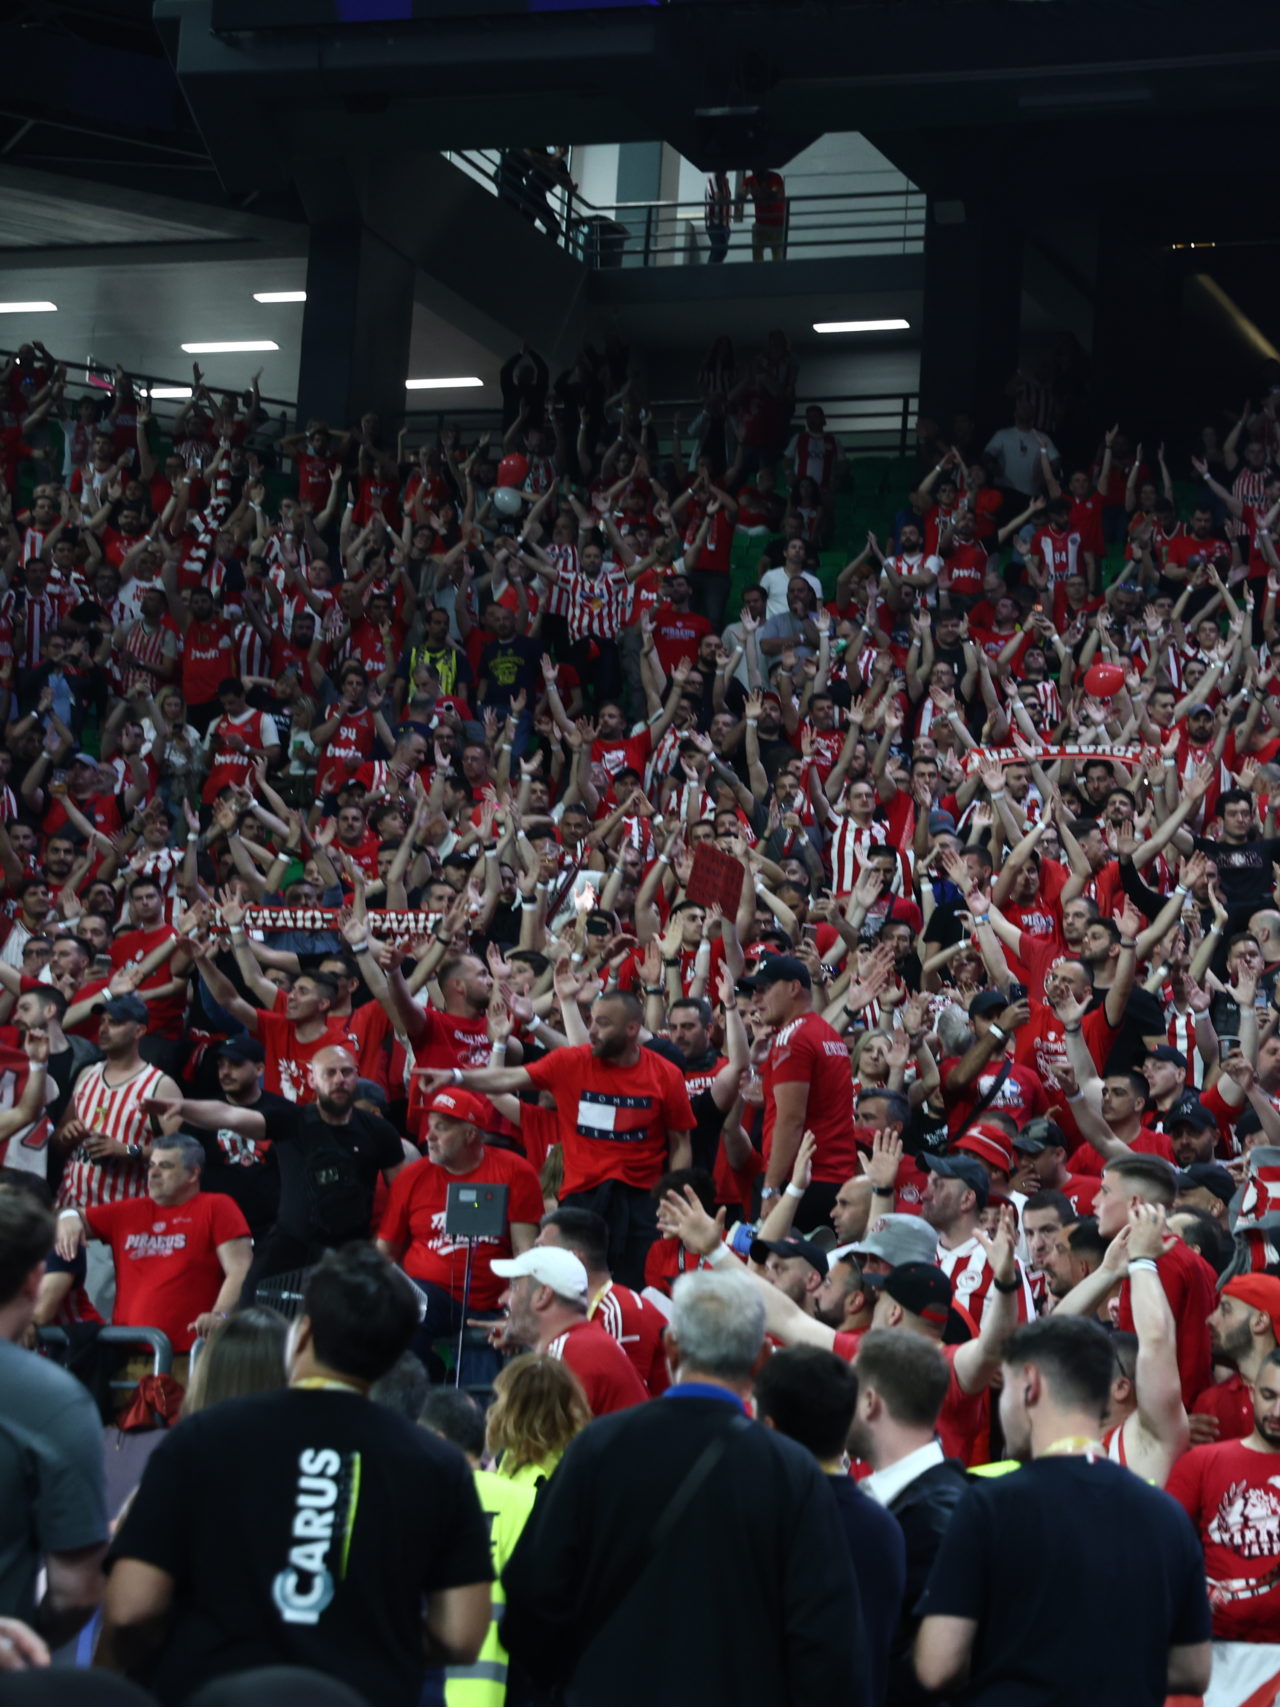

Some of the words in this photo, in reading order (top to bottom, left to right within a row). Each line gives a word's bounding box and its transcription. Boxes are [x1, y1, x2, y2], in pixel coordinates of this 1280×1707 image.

[191, 648, 220, 660] bwin
[364, 658, 386, 672] bw
[326, 742, 362, 758] bwin
[214, 751, 249, 766] bwin
[585, 1092, 650, 1109] TOMMY
[578, 1128, 645, 1141] JEANS
